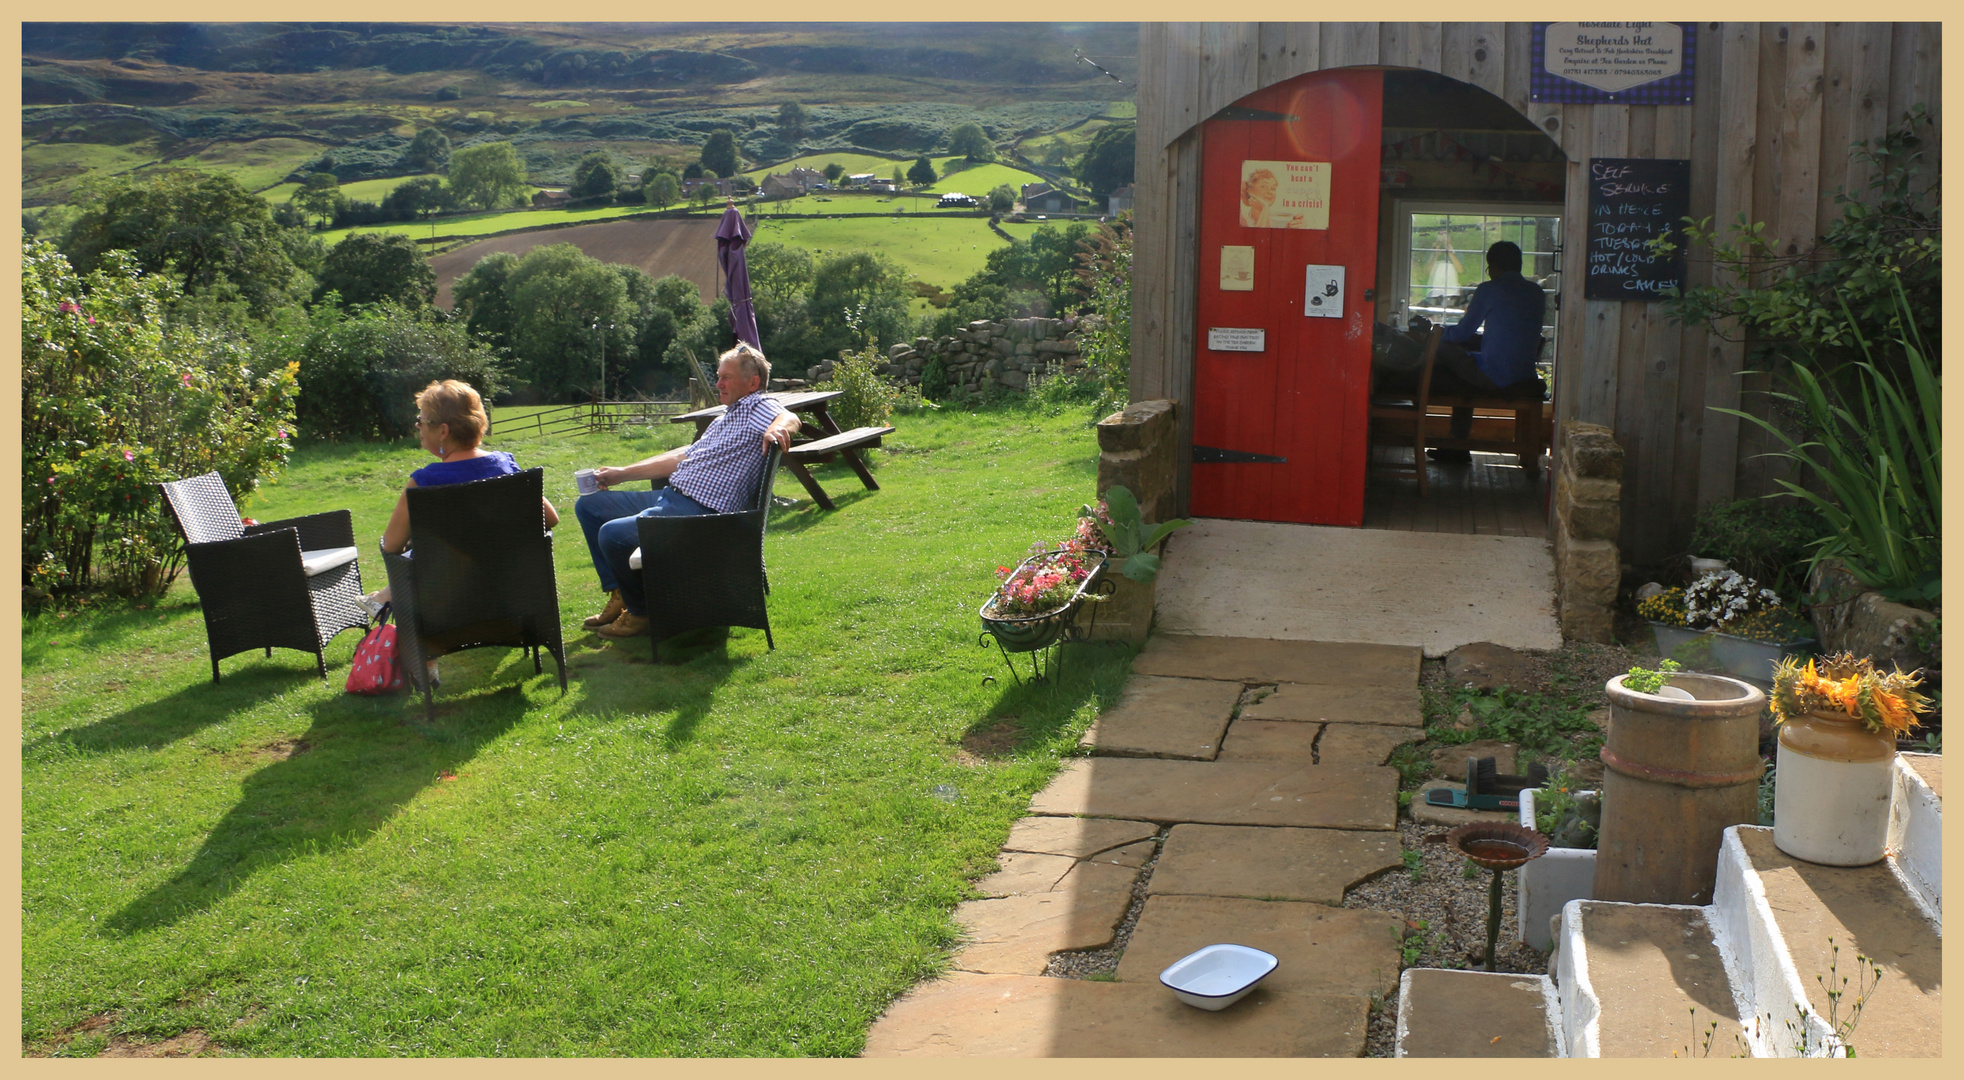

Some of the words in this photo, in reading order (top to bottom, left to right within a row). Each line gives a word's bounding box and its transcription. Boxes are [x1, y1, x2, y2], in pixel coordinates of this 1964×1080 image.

[1576, 34, 1629, 48] Shepherds
[1633, 35, 1654, 46] Hut
[1615, 48, 1644, 56] Yorkshire
[1645, 48, 1673, 56] Breakfast
[1564, 57, 1589, 66] Enquire
[1286, 163, 1299, 171] You
[1300, 164, 1319, 172] can't
[1592, 163, 1633, 181] SELF
[1291, 174, 1306, 182] beat
[1282, 198, 1290, 208] in
[1292, 200, 1296, 208] a
[1298, 199, 1323, 209] crisis!
[1594, 205, 1611, 217] IN
[1594, 222, 1651, 235] TODAY
[1591, 264, 1639, 277] DRINKS
